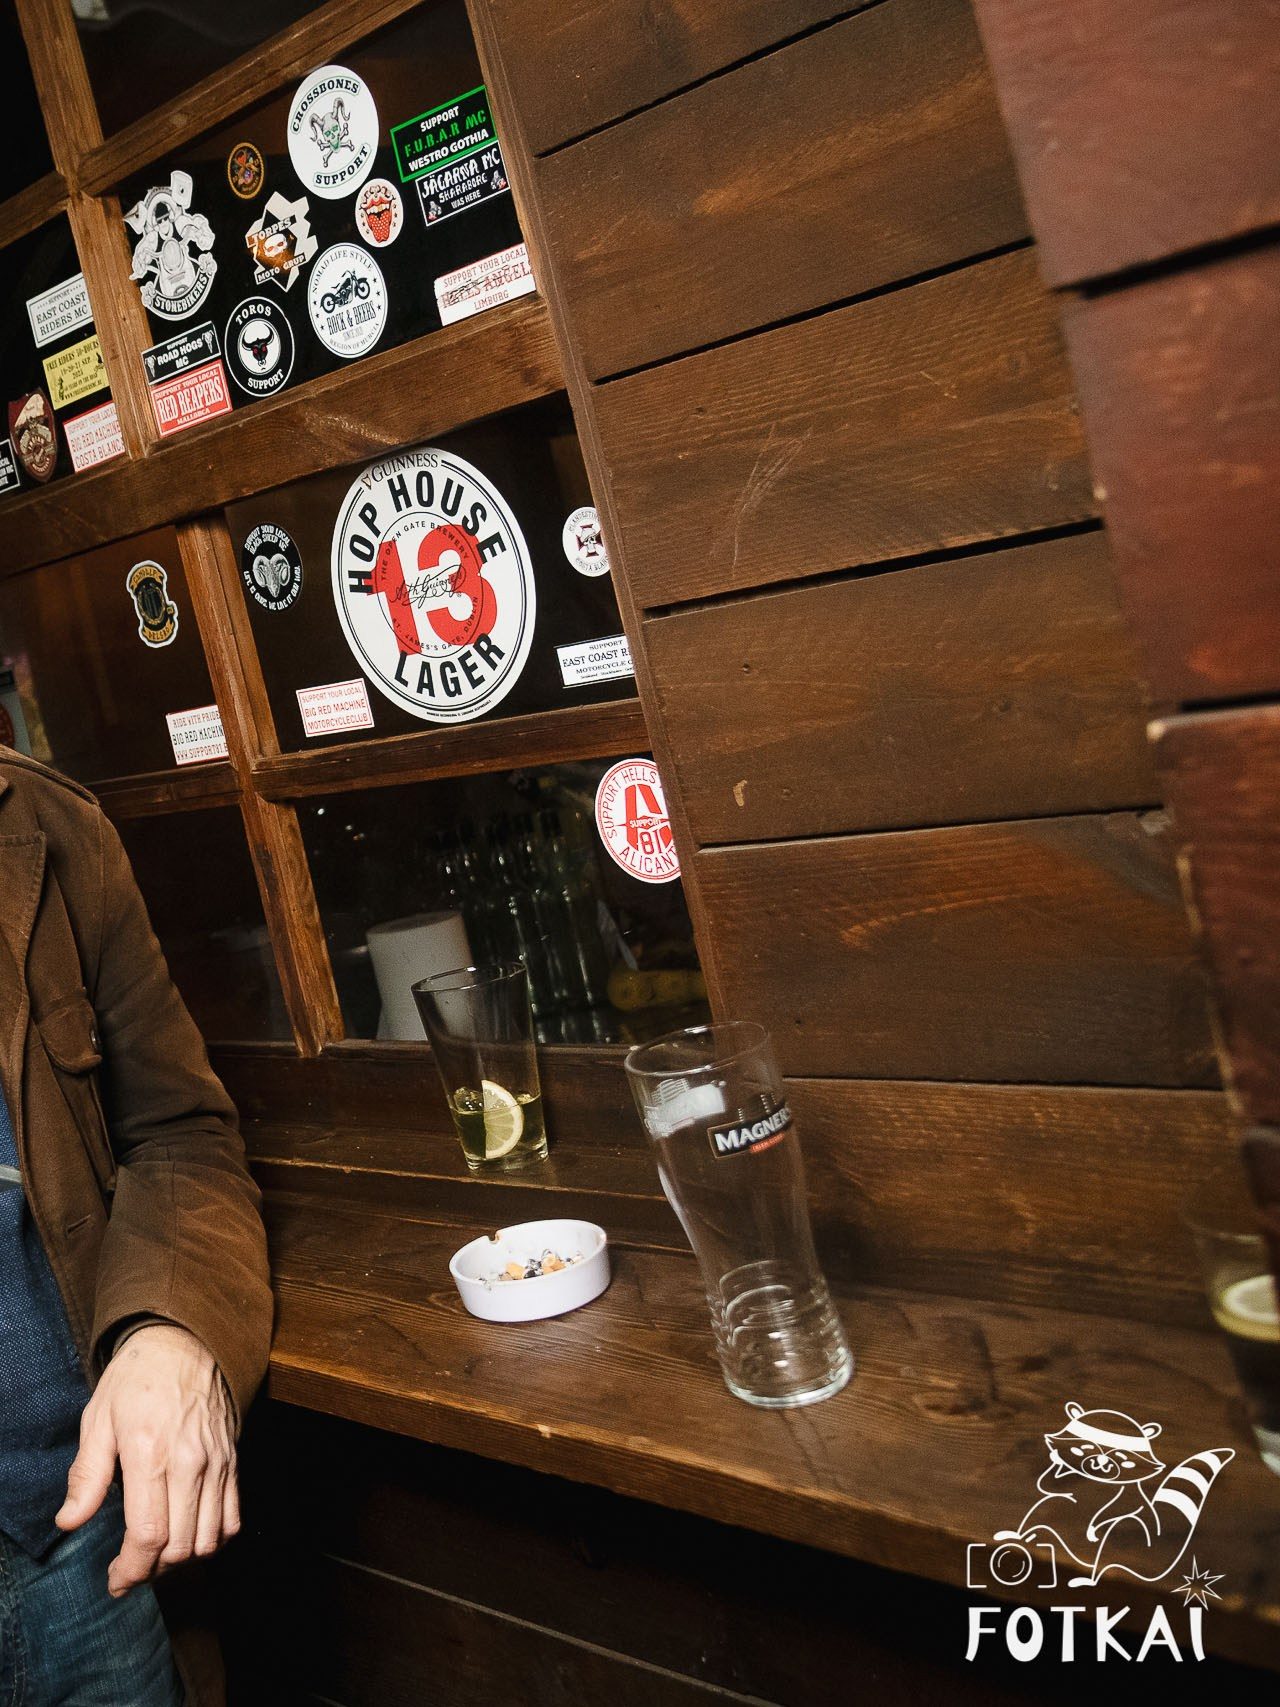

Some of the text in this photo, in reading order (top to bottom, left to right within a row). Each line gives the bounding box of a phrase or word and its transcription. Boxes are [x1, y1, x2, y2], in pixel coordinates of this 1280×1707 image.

[292, 79, 359, 132] CROSSBONES
[420, 106, 459, 132] SUPPORT
[465, 109, 487, 129] MC
[408, 129, 489, 171] WESTRO GOTHIA
[481, 148, 500, 170] MC
[315, 146, 368, 185] SUPPORT
[451, 189, 481, 209] WAS HERE
[252, 217, 292, 243] TORPES
[257, 254, 305, 282] MOTO GRUP
[312, 250, 373, 293] NOMAD LIFE STYLE
[443, 247, 526, 287] SUPPORT YOUR LOCAL
[484, 261, 530, 292] ANGEL
[155, 273, 208, 312] STONEBIKERS
[474, 290, 509, 311] LIMBURG
[36, 291, 87, 324] EAST COAST
[39, 304, 88, 336] RIDERS MC
[235, 303, 272, 325] TOROS
[326, 312, 347, 335] ROCK
[346, 309, 354, 327] &
[352, 300, 377, 325] BEERS
[157, 338, 203, 366] ROAD HOGS
[175, 357, 189, 369] MC
[199, 369, 219, 382] LOCAL
[247, 369, 285, 390] SUPPORT
[157, 376, 224, 424] RED REAPERS
[177, 408, 211, 425] MALLORCA
[75, 449, 98, 468] COSTA
[371, 453, 438, 482] GUINNESS
[275, 528, 291, 547] LOCAL
[347, 470, 507, 594] HOP HOUSE
[386, 531, 402, 555] OPEN
[404, 521, 426, 532] GATE
[430, 522, 470, 559] BREWERY
[364, 524, 497, 656] 13
[464, 597, 478, 633] DUBLIN
[562, 655, 586, 668] EAST
[588, 649, 618, 663] COAST
[589, 640, 623, 650] SUPPORT
[395, 632, 506, 698] LAGER
[576, 660, 626, 674] MOTORCYCLE
[328, 690, 343, 698] YOUR
[344, 687, 362, 696] LOCAL
[304, 698, 366, 718] BIG RED MACHINE
[172, 725, 225, 746] BIG RED MACHIN
[602, 767, 657, 839] SUPPORT HELLS
[629, 817, 661, 829] SUPPORT
[640, 829, 663, 855] 81
[619, 845, 679, 874] ALICANT
[715, 1107, 791, 1152] MAGNER
